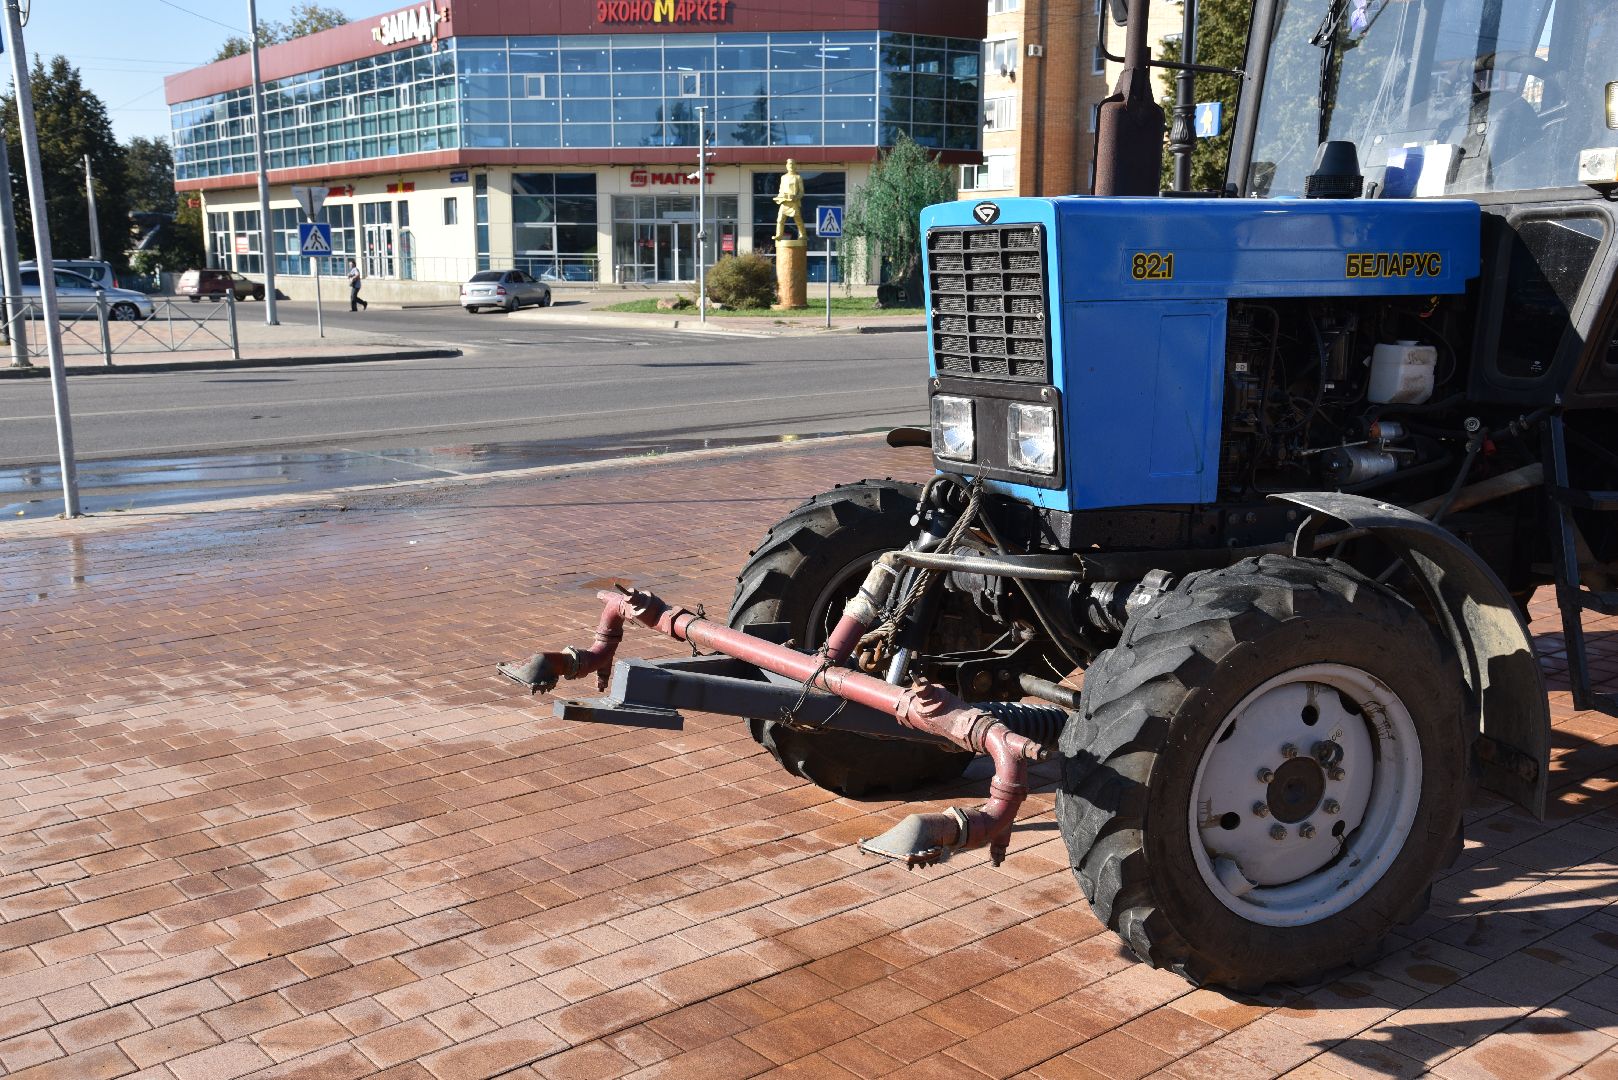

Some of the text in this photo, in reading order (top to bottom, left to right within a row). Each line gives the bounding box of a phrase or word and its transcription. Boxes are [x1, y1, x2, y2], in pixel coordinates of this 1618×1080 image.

[597, 0, 728, 23] ЭКОНОМАРКЕТ
[381, 6, 431, 45] ЗАПАД
[1132, 252, 1174, 279] 82.1
[1346, 252, 1442, 278] БЕЛАРУС
